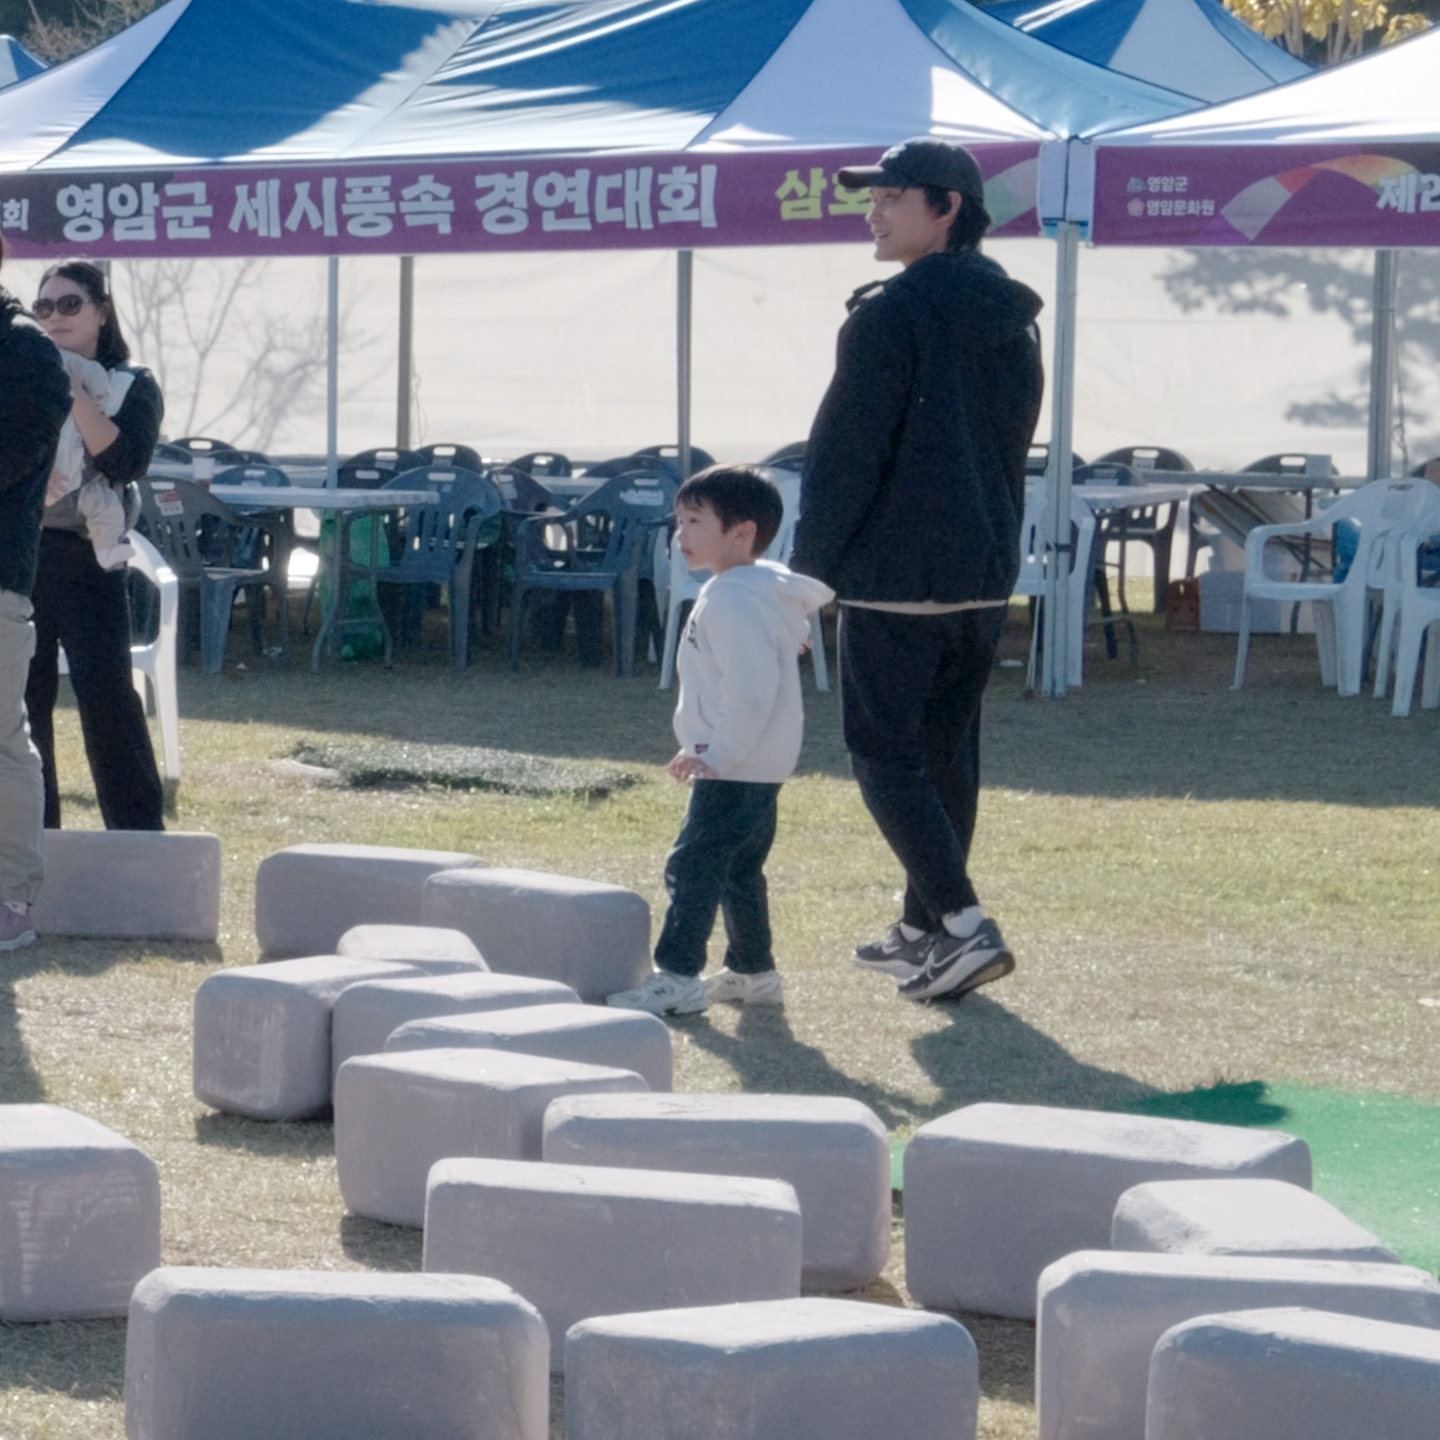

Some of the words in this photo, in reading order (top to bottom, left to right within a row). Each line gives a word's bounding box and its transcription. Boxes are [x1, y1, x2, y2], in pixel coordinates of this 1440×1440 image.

[1147, 176, 1188, 193] 영암군
[56, 180, 213, 242] 영암군
[228, 174, 455, 238] 세시풍속
[475, 164, 718, 235] 경연대회
[1146, 199, 1215, 217] 영암문화원
